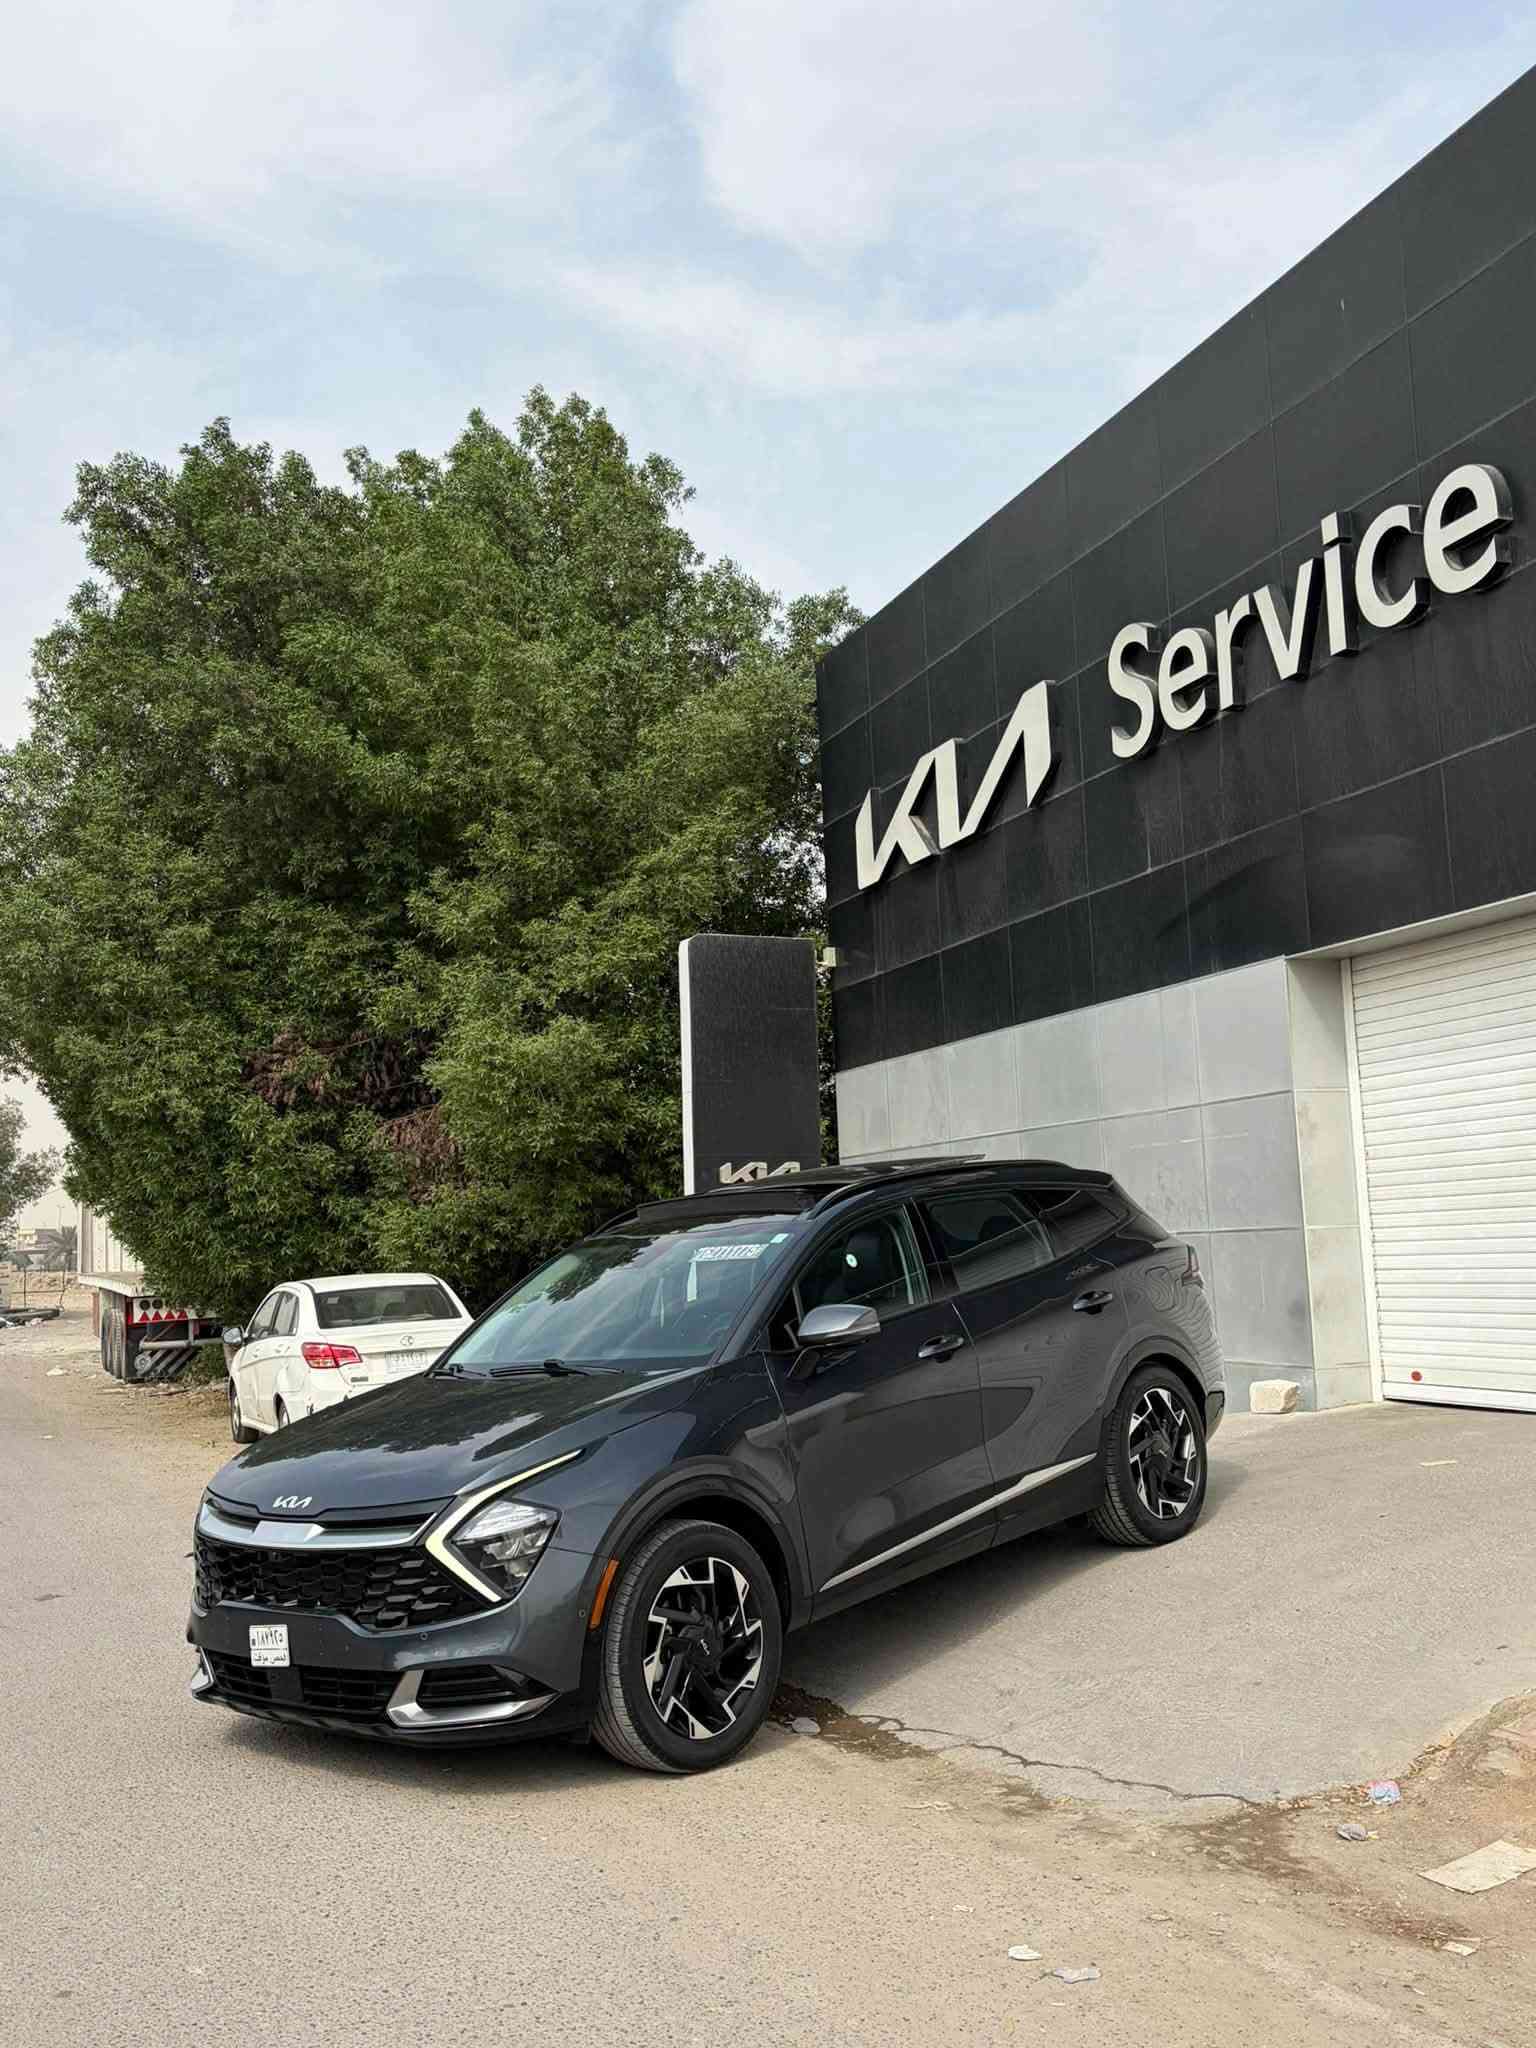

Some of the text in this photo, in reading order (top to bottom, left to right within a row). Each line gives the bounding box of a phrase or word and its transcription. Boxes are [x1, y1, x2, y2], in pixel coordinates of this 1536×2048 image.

[855, 463, 1511, 890] KIA Service
[272, 1495, 312, 1509] KIA
